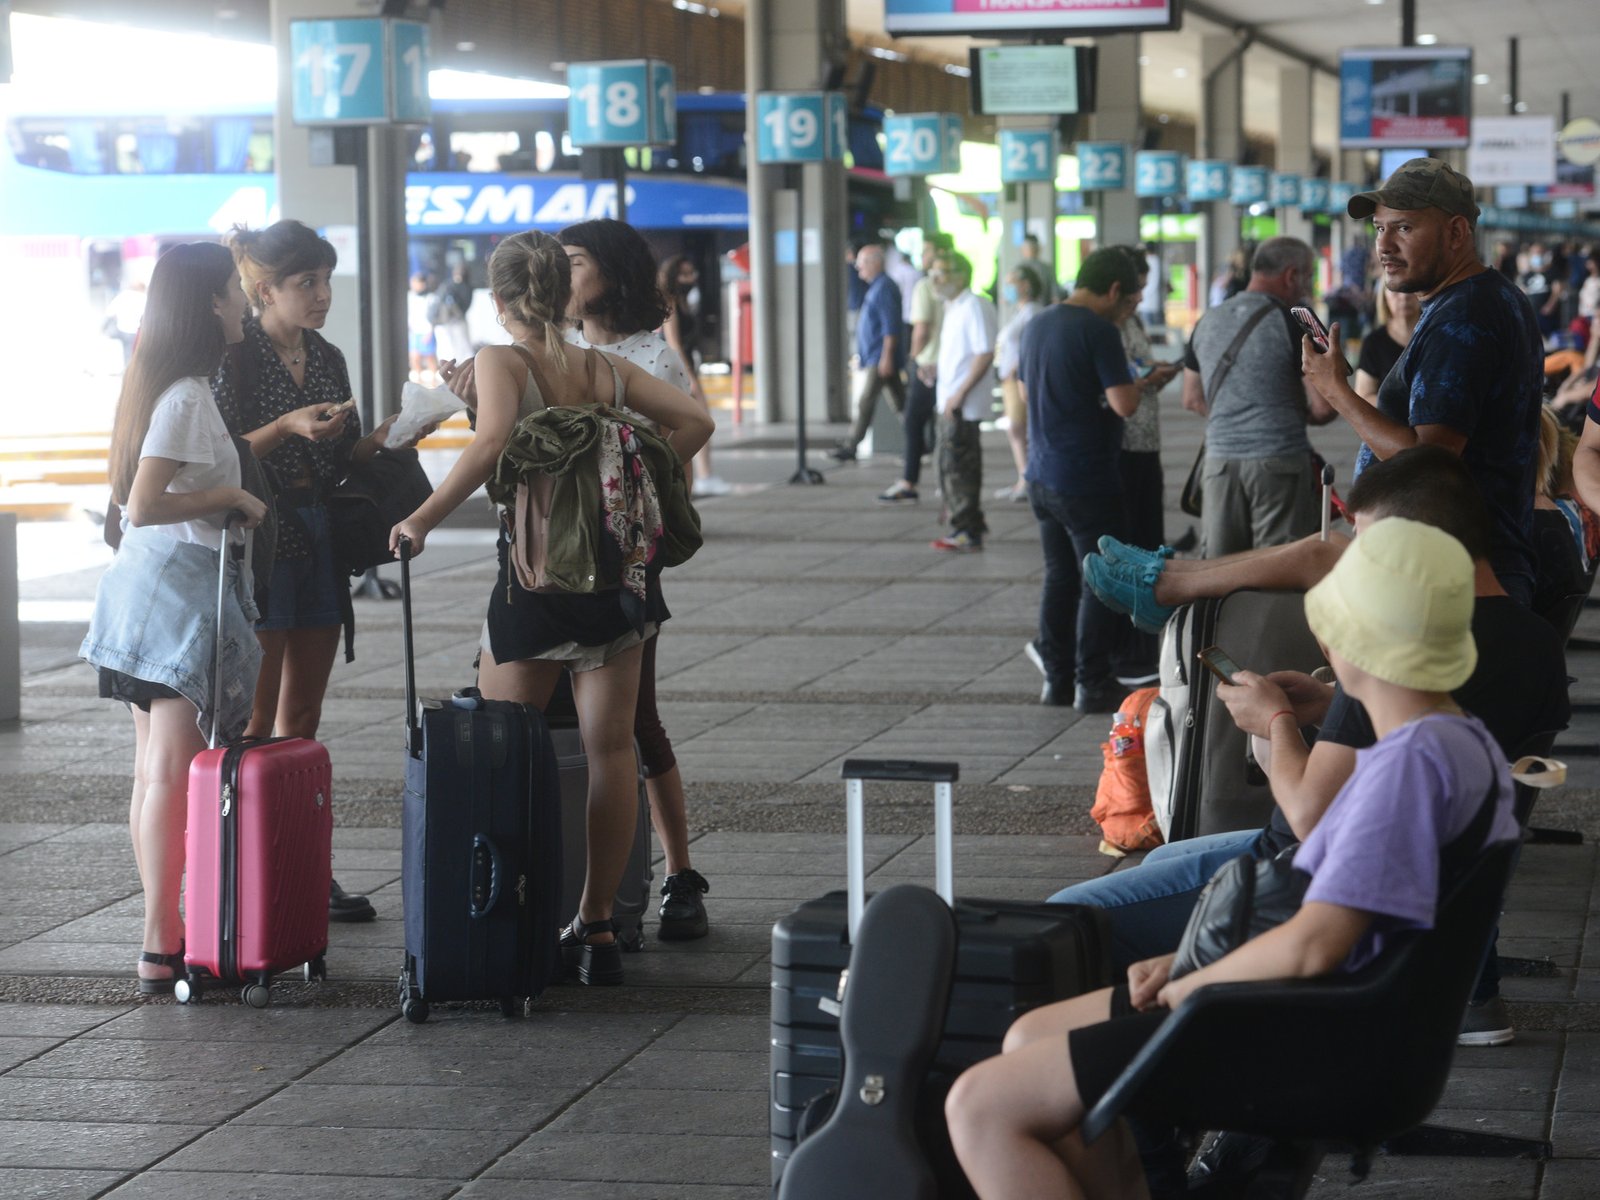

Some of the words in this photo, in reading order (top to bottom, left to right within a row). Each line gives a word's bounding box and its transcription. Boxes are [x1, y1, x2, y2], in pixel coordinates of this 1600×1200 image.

[297, 43, 371, 97] 17
[576, 81, 640, 128] 18
[763, 108, 817, 148] 19
[890, 127, 937, 162] 20
[1006, 140, 1047, 171] 21
[1083, 152, 1121, 181] 22
[1142, 160, 1176, 188] 23
[1191, 168, 1224, 194] 24
